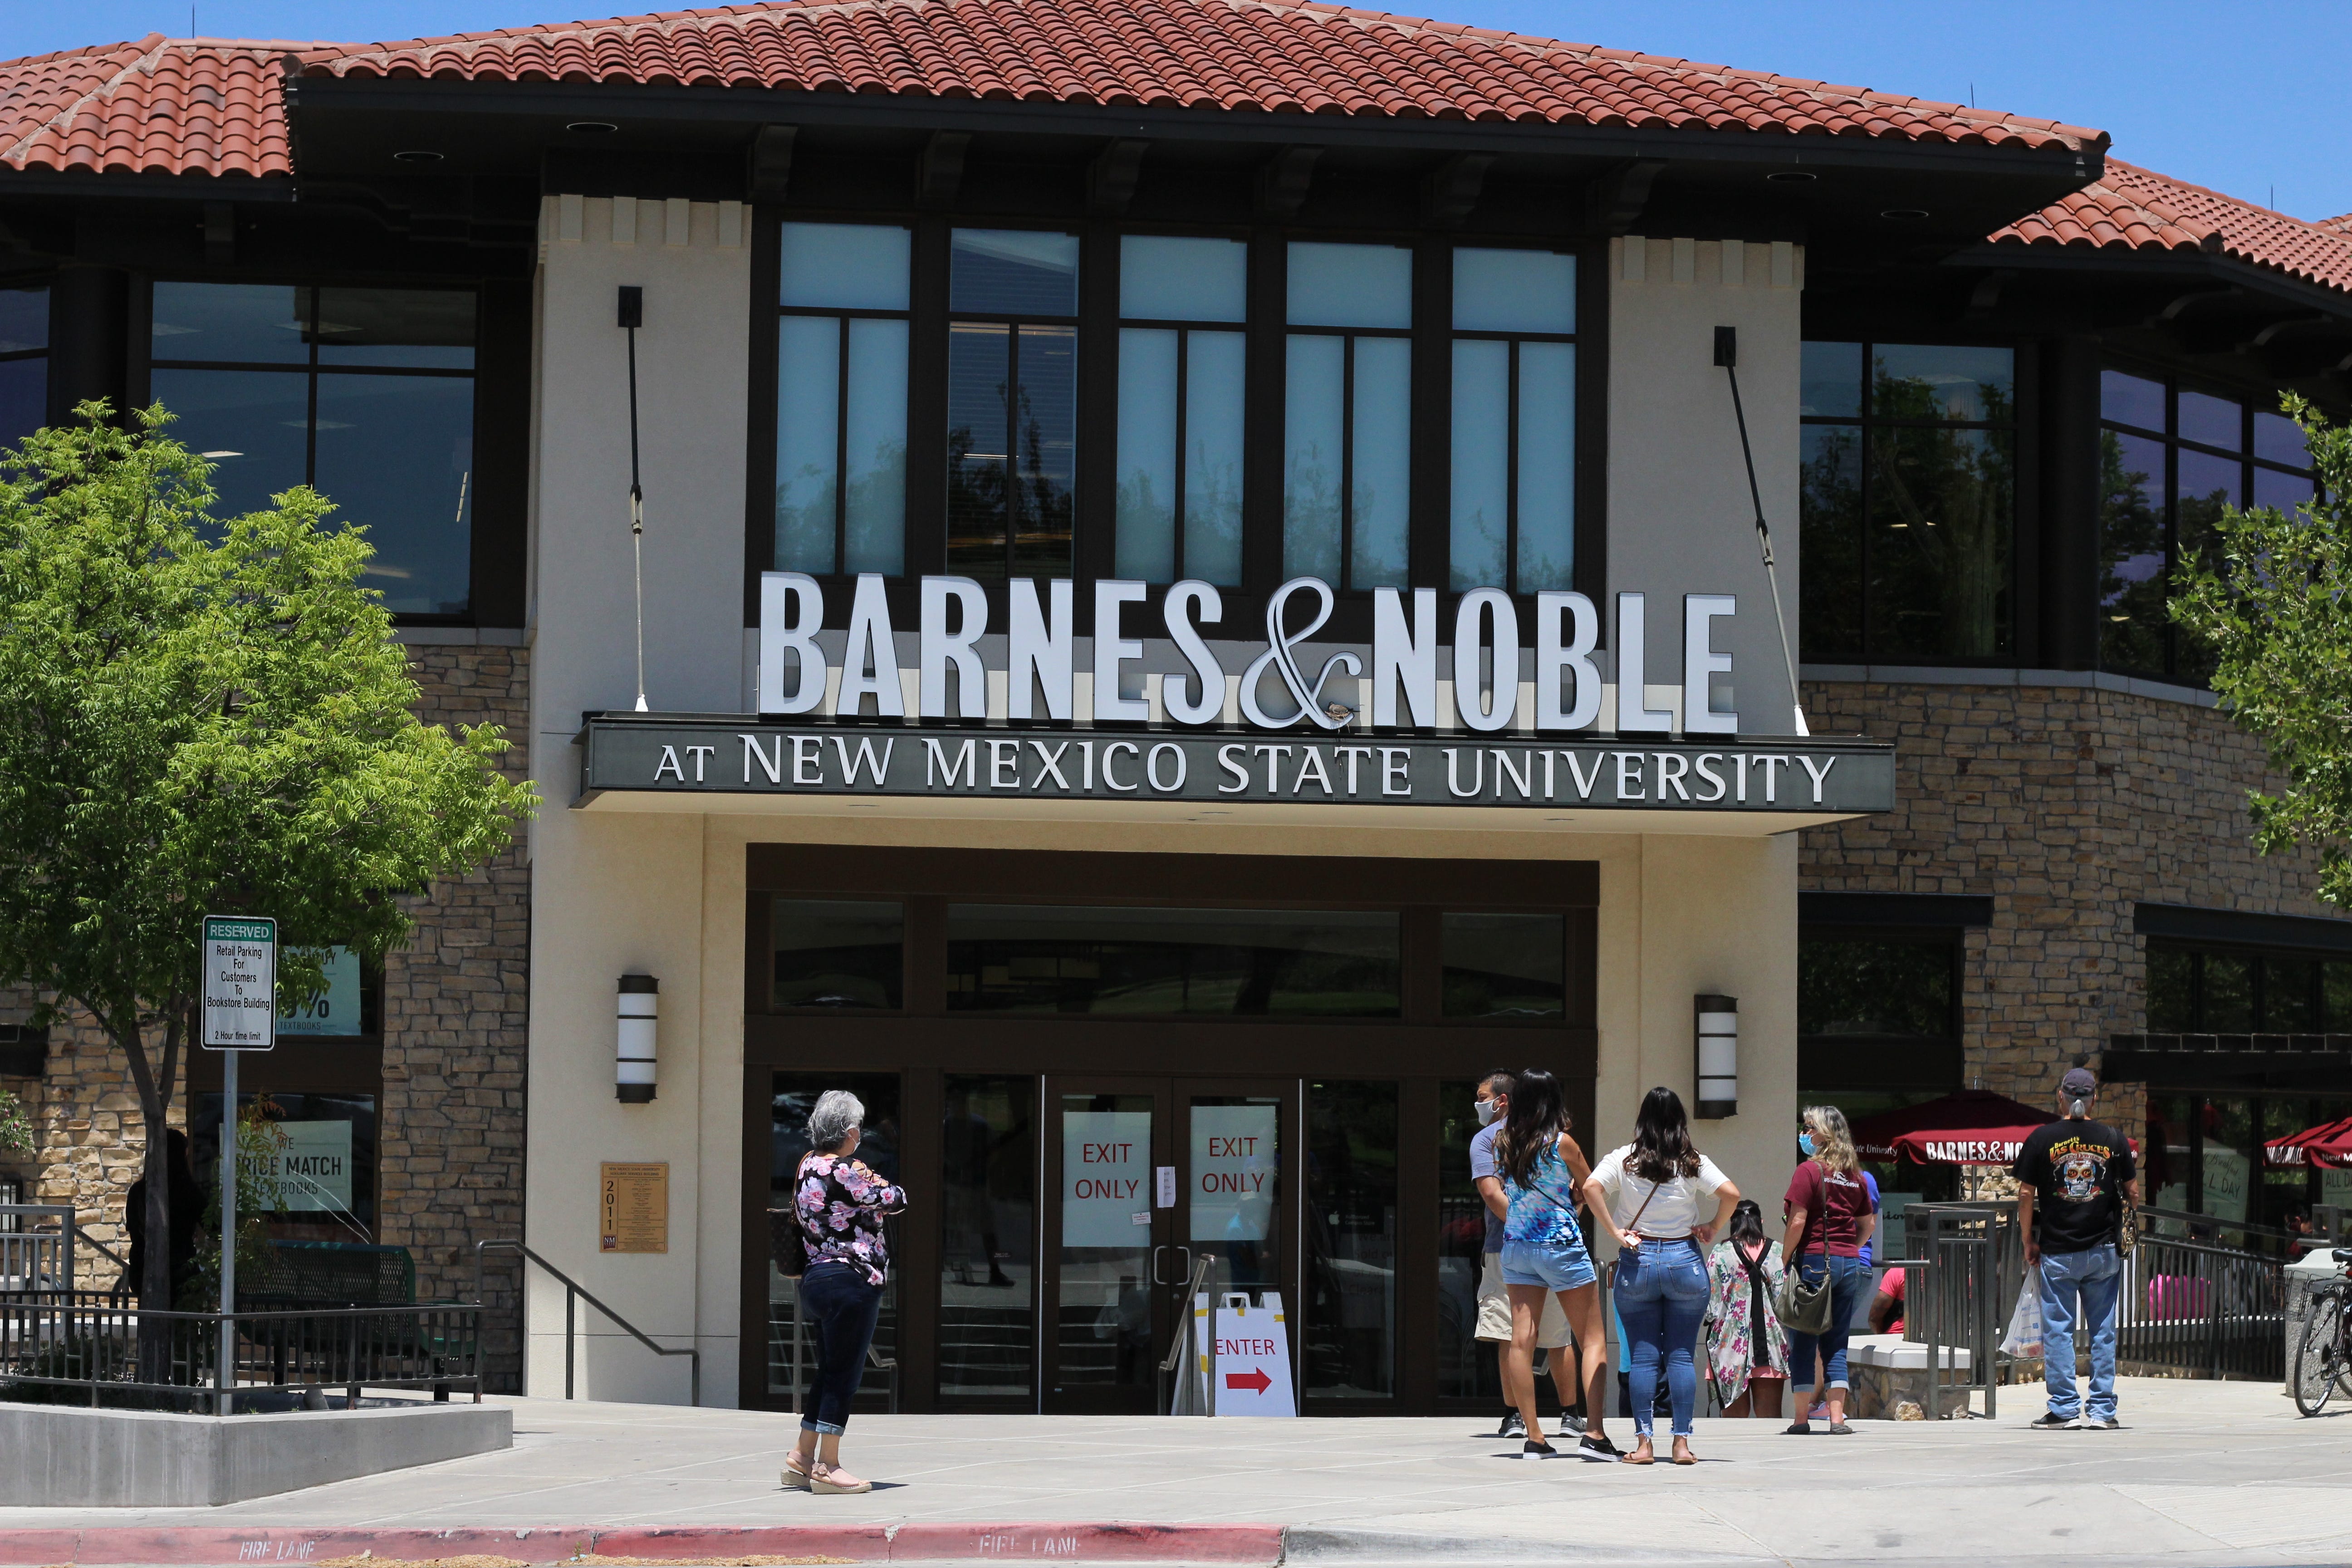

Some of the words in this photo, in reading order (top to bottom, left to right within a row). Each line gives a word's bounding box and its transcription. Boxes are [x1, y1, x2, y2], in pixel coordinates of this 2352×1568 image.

[760, 571, 1226, 725] BARNES
[1372, 586, 1739, 734] NOBLE
[654, 745, 715, 782] AT
[738, 734, 894, 786] NEW
[921, 738, 1186, 792] MEXICO
[1217, 743, 1412, 796] STATE
[1442, 747, 1837, 803] UNIVERSITY
[210, 925, 269, 938] RESERVED
[216, 945, 235, 956] Retail
[237, 946, 262, 959] Parking
[233, 958, 245, 969] For
[221, 971, 257, 982] Customers
[235, 985, 243, 995] To
[207, 996, 241, 1008] Bookstore
[244, 998, 270, 1011] Building
[279, 1021, 321, 1030] TEXTBOOKS
[215, 1031, 219, 1039] 2
[220, 1031, 233, 1039] Hour
[235, 1031, 247, 1040] time
[249, 1032, 260, 1040] limit
[278, 1137, 294, 1150] WE
[1209, 1137, 1258, 1157] EXIT
[1855, 1145, 1865, 1153] ate
[1867, 1144, 1898, 1156] University
[2054, 1136, 2080, 1149] Barnett's
[1083, 1143, 1132, 1163] EXIT
[1926, 1141, 1987, 1161] BARNES
[2049, 1145, 2068, 1163] LAS
[2069, 1141, 2110, 1159] CRUCES
[2322, 1153, 2340, 1161] New
[286, 1156, 341, 1176] MATCH
[1202, 1172, 1264, 1193] ONLY
[2325, 1172, 2342, 1188] ALL
[1075, 1178, 1139, 1199] ONLY
[2221, 1177, 2241, 1199] DAY
[1215, 1339, 1276, 1355] ENTER
